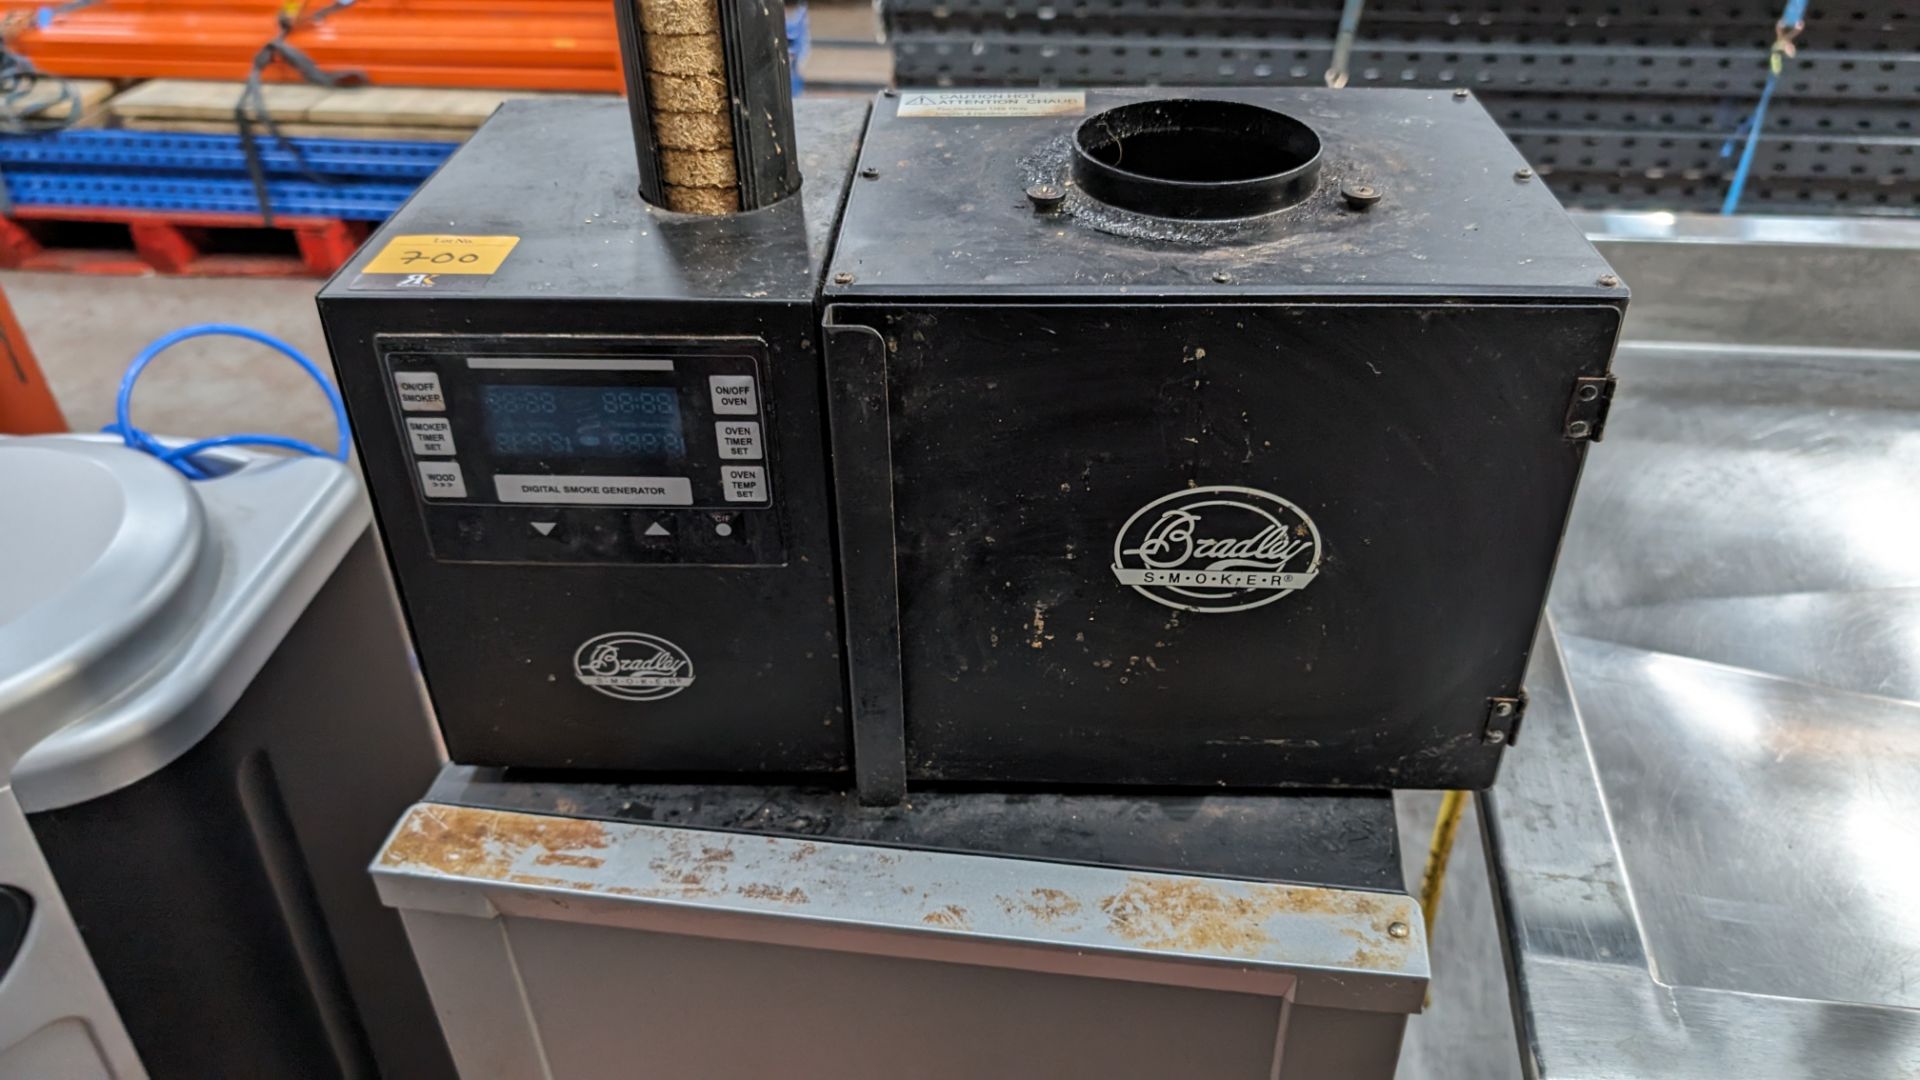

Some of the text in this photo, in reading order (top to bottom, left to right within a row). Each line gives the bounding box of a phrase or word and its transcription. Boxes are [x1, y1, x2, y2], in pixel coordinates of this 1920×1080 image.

[400, 251, 479, 265] 700
[402, 383, 434, 391] ON/OFF
[715, 386, 750, 394] ON/OFF
[402, 394, 440, 402] SMOKER
[721, 398, 748, 406] OVEN
[410, 423, 448, 431] SMOKER
[725, 427, 751, 435] OVEN
[725, 438, 753, 446] TIMER
[424, 443, 442, 451] SET
[731, 447, 749, 455] SET
[427, 474, 456, 482] WOOD
[730, 471, 756, 479] OVEN
[521, 485, 666, 495] DIGITAL SMOKE GENERATOR
[1123, 510, 1313, 570] Bradley
[581, 644, 687, 677] Bradley
